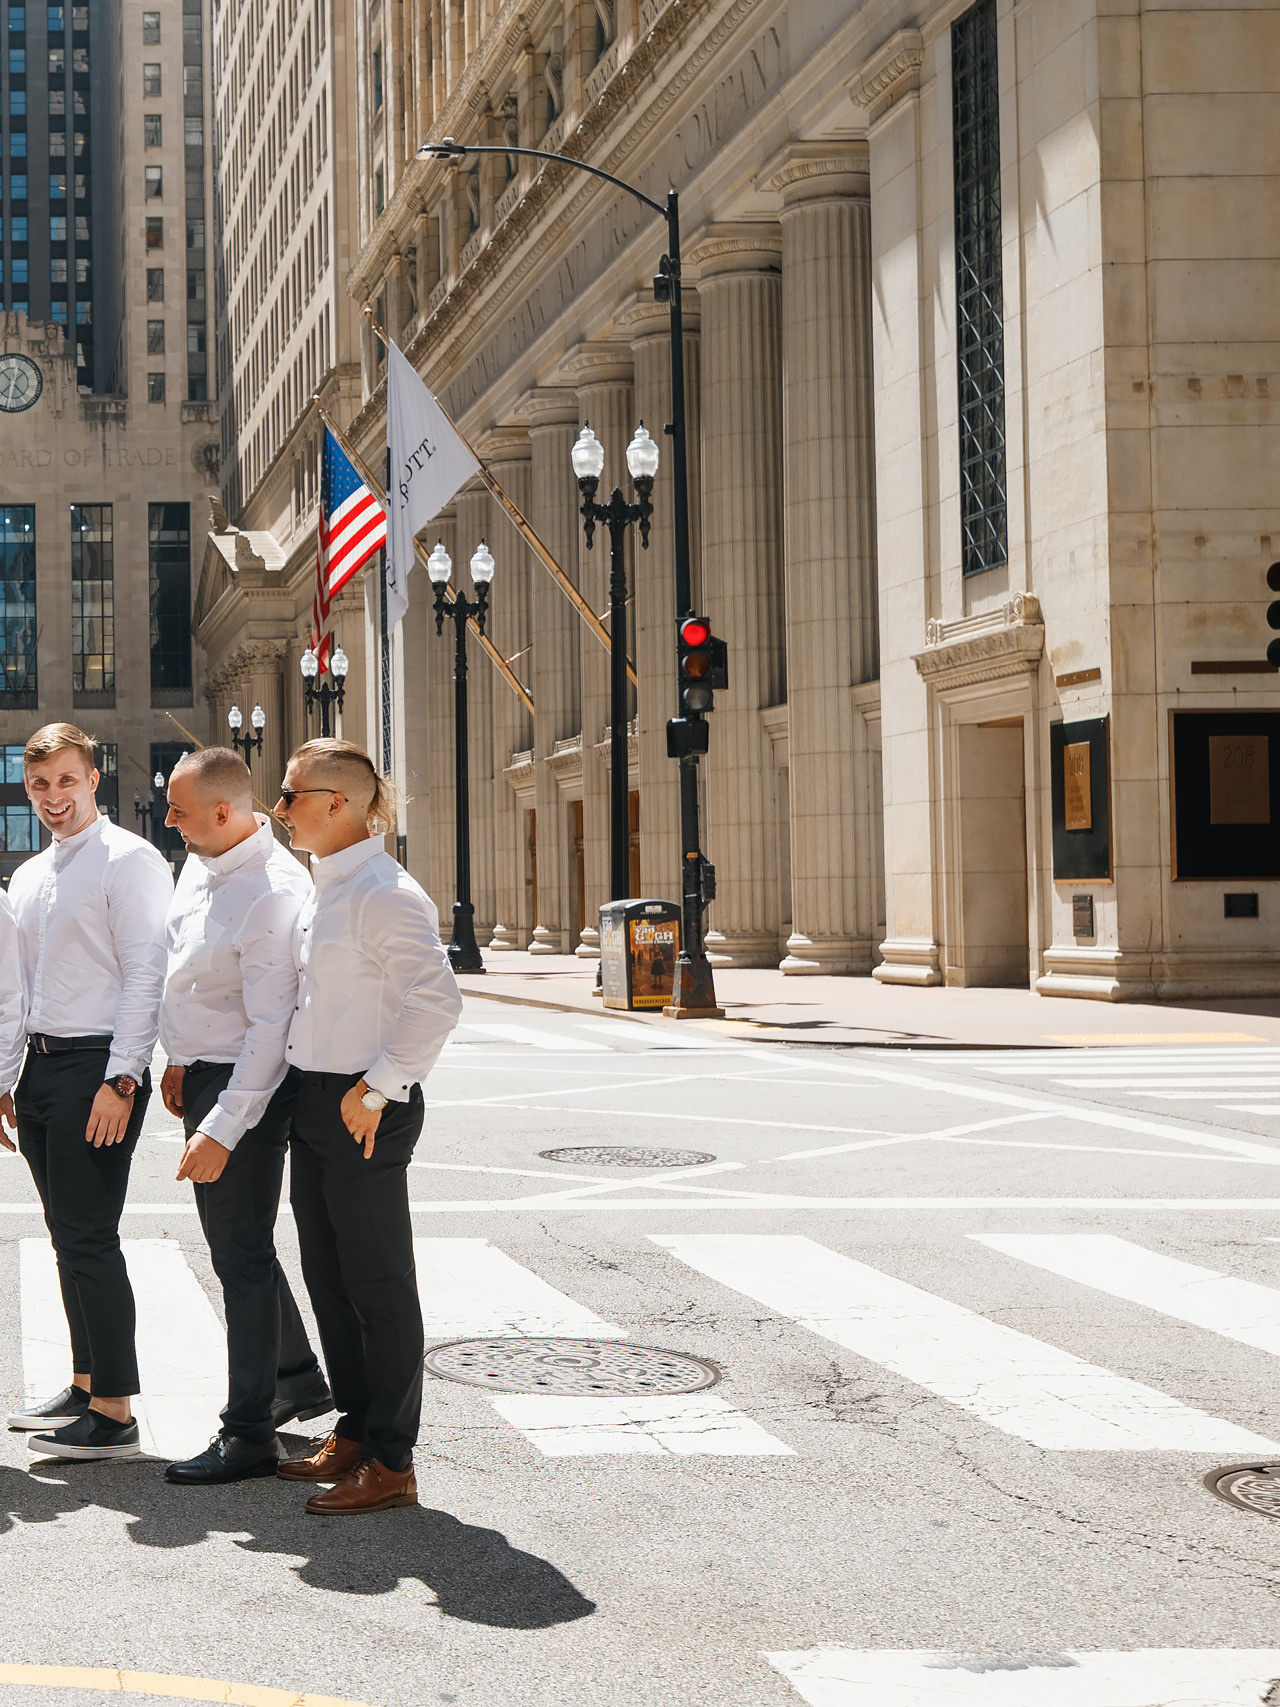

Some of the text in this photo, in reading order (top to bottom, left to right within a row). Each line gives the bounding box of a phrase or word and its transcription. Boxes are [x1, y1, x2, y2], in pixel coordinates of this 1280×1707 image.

[667, 12, 788, 188] COMPANY
[63, 448, 94, 468] OF
[104, 447, 177, 468] TRADE
[1223, 744, 1255, 768] 208
